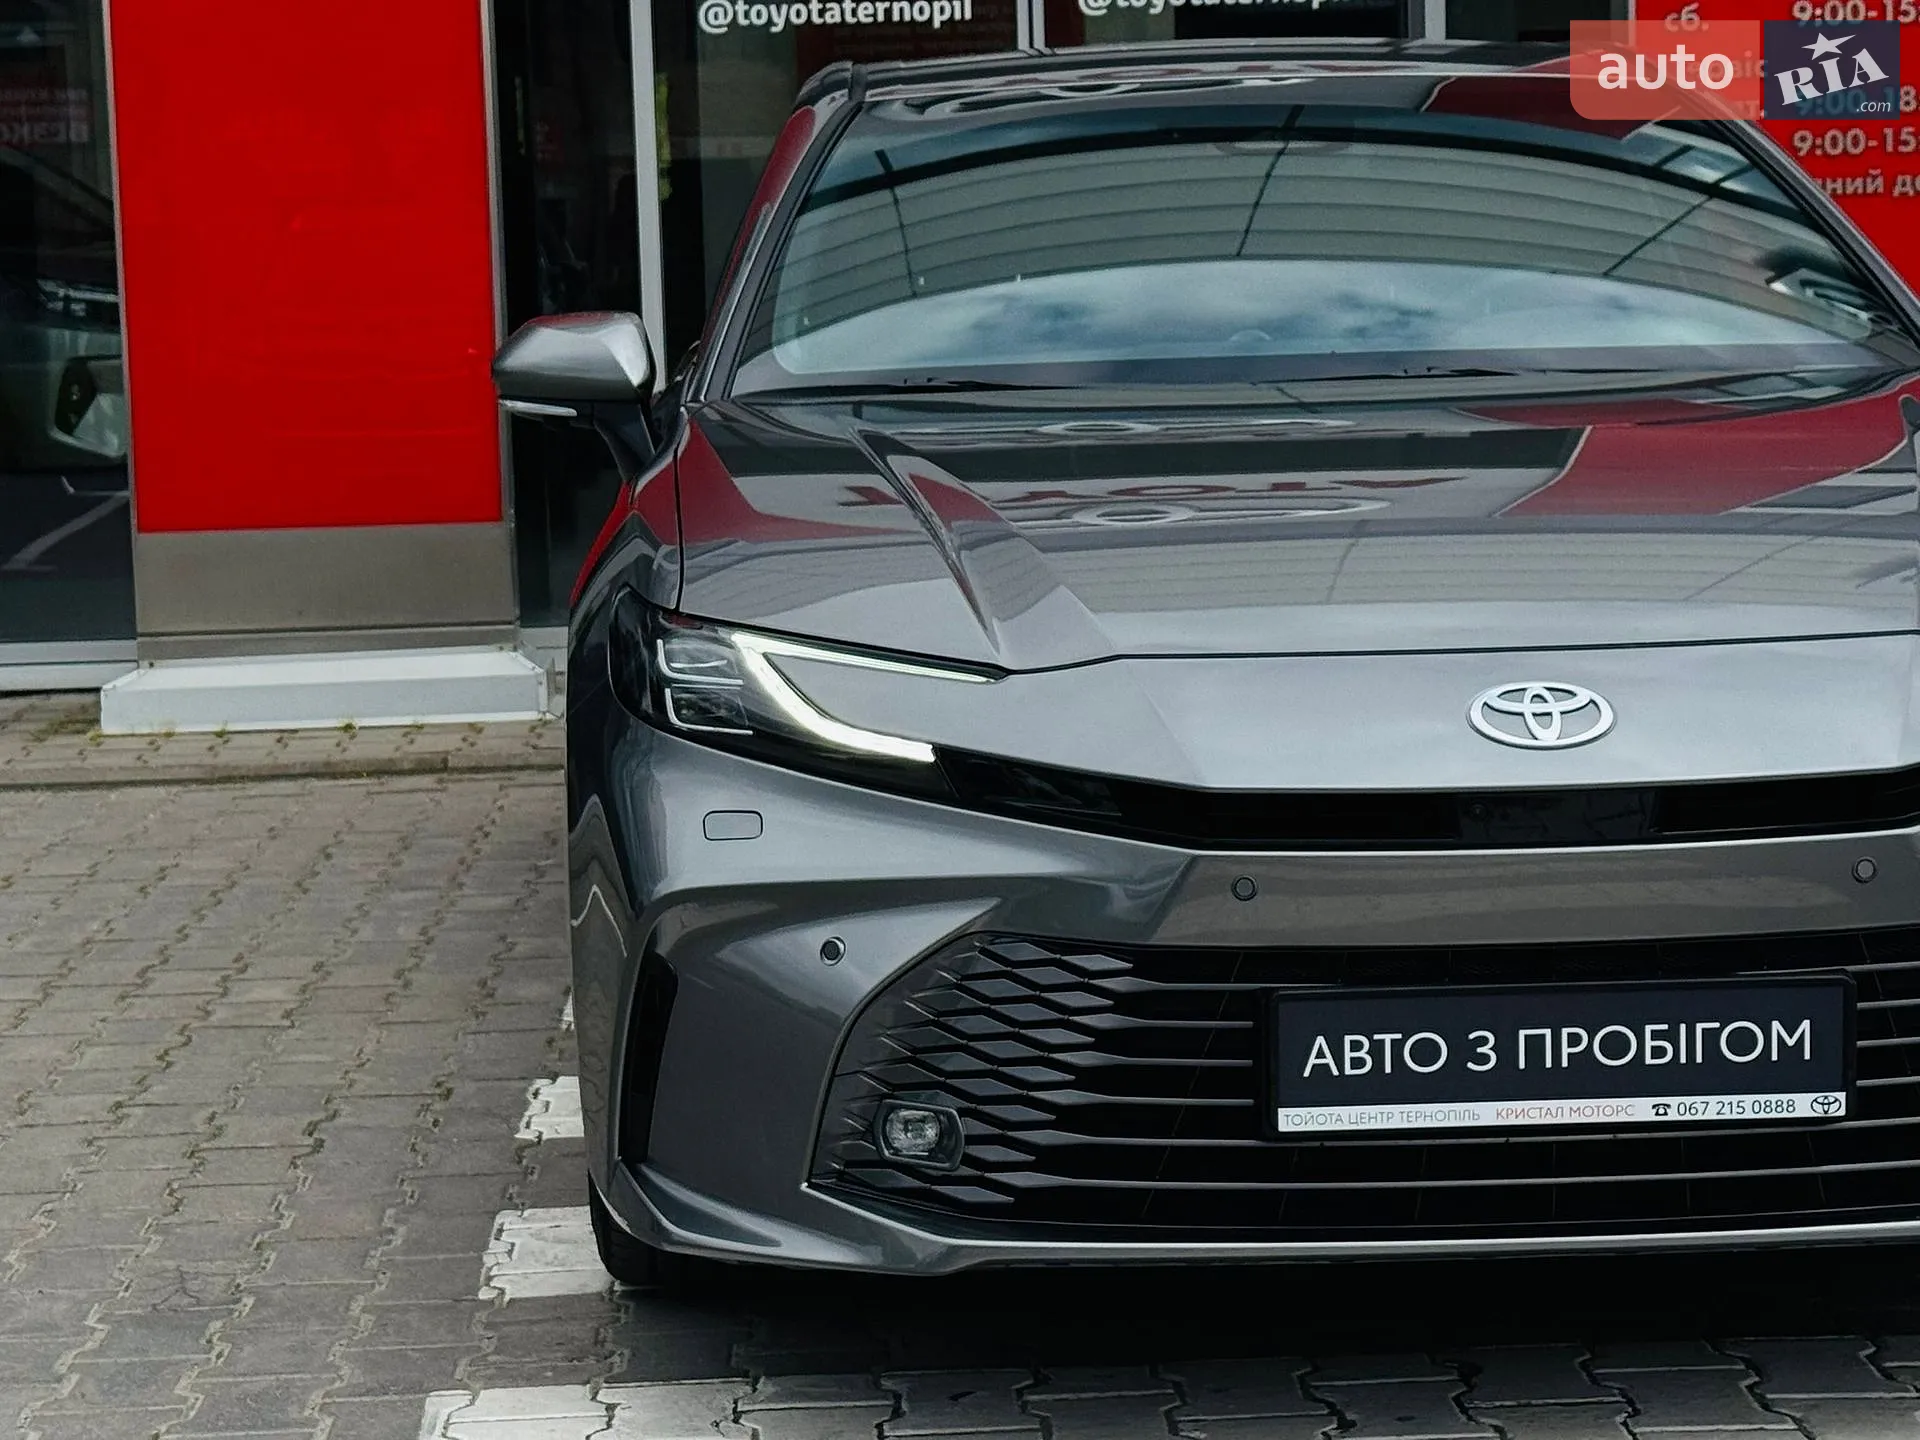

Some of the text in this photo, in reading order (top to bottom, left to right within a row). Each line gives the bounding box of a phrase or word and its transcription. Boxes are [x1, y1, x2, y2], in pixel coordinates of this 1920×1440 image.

[698, 0, 972, 34] @toyotaternopil
[1792, 0, 1920, 27] 9:00-15
[1793, 126, 1920, 155] 9:00-15
[1303, 1032, 1449, 1078] АВТО
[1518, 1019, 1811, 1069] ПРОБІГОМ
[1284, 1098, 1796, 1127] ТОЙОТА ЦЕНТР ТЕРНОПІЛЬ КРИСТАЛ МОТОРС 067 215 0888
